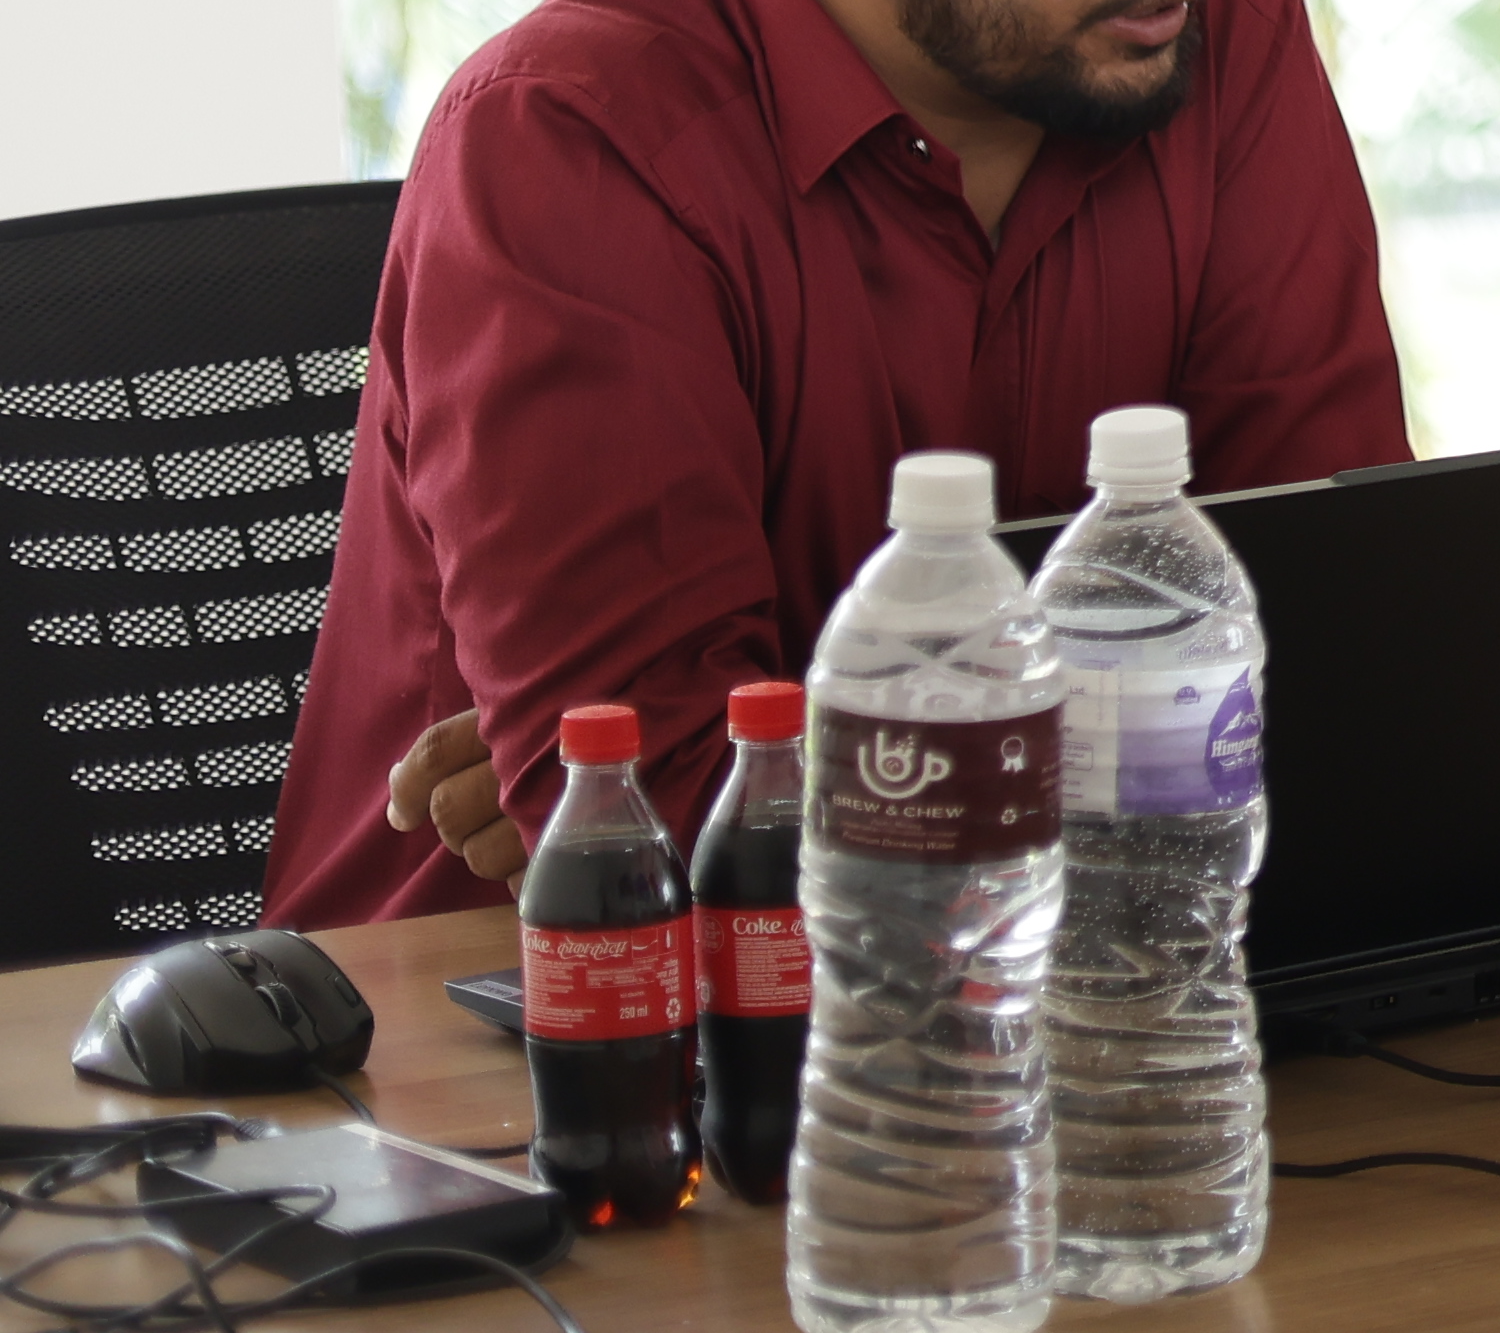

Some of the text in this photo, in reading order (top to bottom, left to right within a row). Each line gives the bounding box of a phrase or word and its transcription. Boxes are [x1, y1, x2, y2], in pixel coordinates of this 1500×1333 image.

[832, 794, 965, 819] BREW & CHEW
[733, 917, 782, 935] Coke
[523, 930, 551, 954] Coke
[619, 1004, 648, 1020] 250 ml
